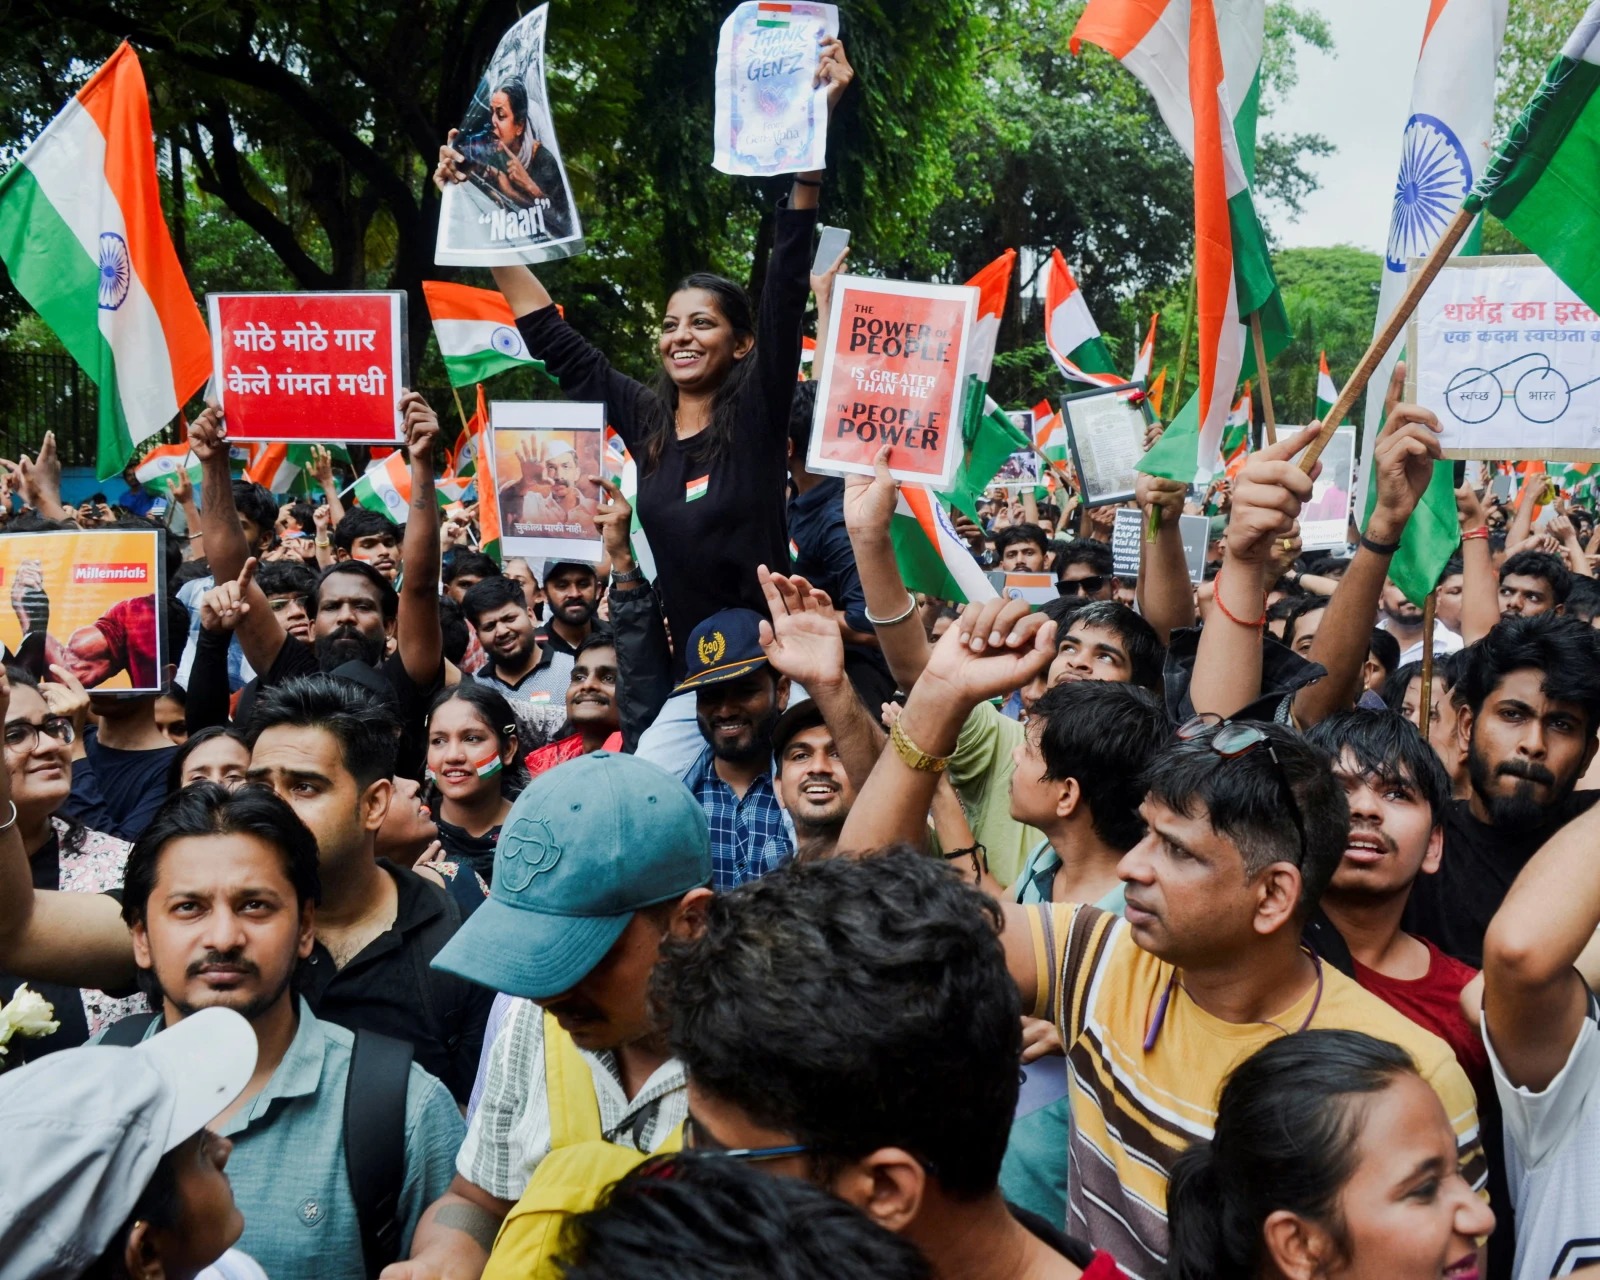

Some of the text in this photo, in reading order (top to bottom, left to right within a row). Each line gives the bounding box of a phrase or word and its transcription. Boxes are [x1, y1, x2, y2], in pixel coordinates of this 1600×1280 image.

[747, 52, 804, 82] GEN-Z
[854, 304, 874, 314] THE
[1512, 302, 1546, 321] का
[233, 321, 376, 351] मोठे मोठे गार
[852, 316, 948, 340] POWER OF
[1444, 331, 1472, 344] एक
[1477, 330, 1518, 343] कदम
[1524, 330, 1586, 342] स्वच्छता
[850, 333, 951, 362] PEOPLE
[228, 366, 386, 396] केले गंमत मधी
[851, 366, 936, 388] IS GREATER
[856, 379, 928, 398] THAN THE
[1528, 391, 1556, 400] भारत
[837, 402, 941, 429] IN PEOPLE
[837, 418, 939, 450] POWER
[76, 567, 145, 579] Millennials
[704, 642, 718, 654] 290
